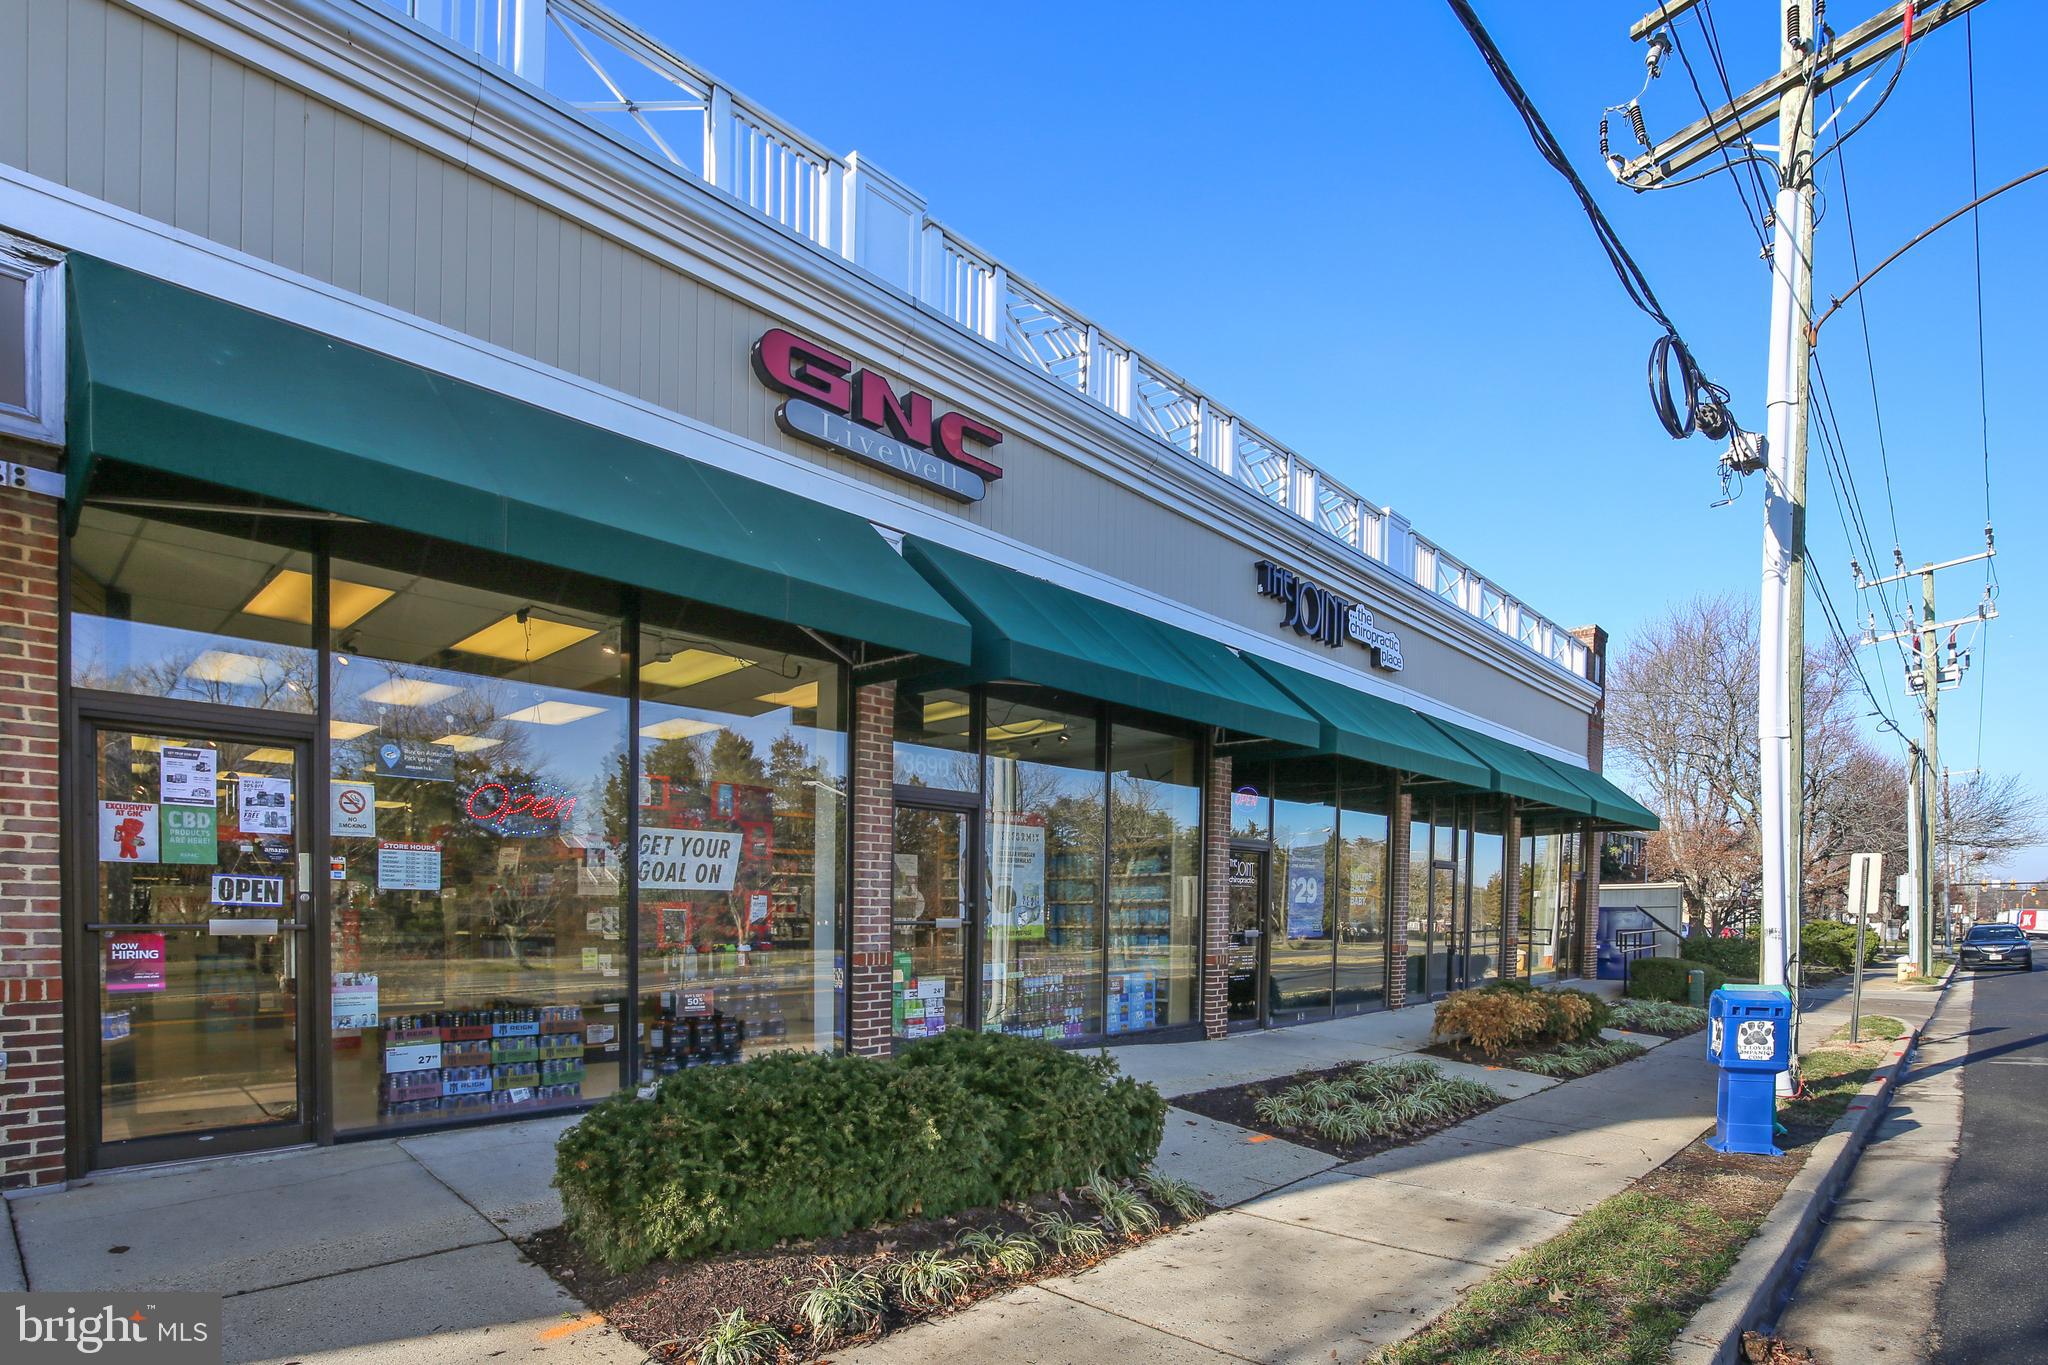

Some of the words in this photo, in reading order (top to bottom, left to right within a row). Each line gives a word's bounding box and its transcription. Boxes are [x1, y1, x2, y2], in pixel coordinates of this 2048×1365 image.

[752, 328, 1003, 482] GNC
[1255, 560, 1294, 602] THE
[1280, 577, 1349, 648] JOINT
[1349, 621, 1399, 652] chiropractic
[1381, 649, 1402, 668] place
[105, 803, 153, 812] EXCLUSIVELY
[465, 783, 577, 824] Open
[127, 810, 143, 818] GNC
[168, 810, 211, 829] CBD
[169, 829, 211, 837] PRODUCTS
[169, 837, 185, 845] ARE
[187, 837, 211, 845] HERE!
[383, 842, 409, 850] STORE
[410, 844, 436, 852] HOURS
[639, 833, 675, 856] GET
[681, 836, 732, 860] YOUR
[638, 860, 688, 884] GOAL
[695, 863, 723, 884] ON
[1235, 861, 1255, 877] JOINT
[1229, 876, 1255, 885] chiropractic
[218, 877, 279, 903] OPEN
[1291, 877, 1317, 904] $29
[111, 950, 160, 960] HIRING
[407, 1030, 433, 1038] REIGN
[418, 1056, 431, 1065] 27
[461, 1081, 485, 1089] REIGN
